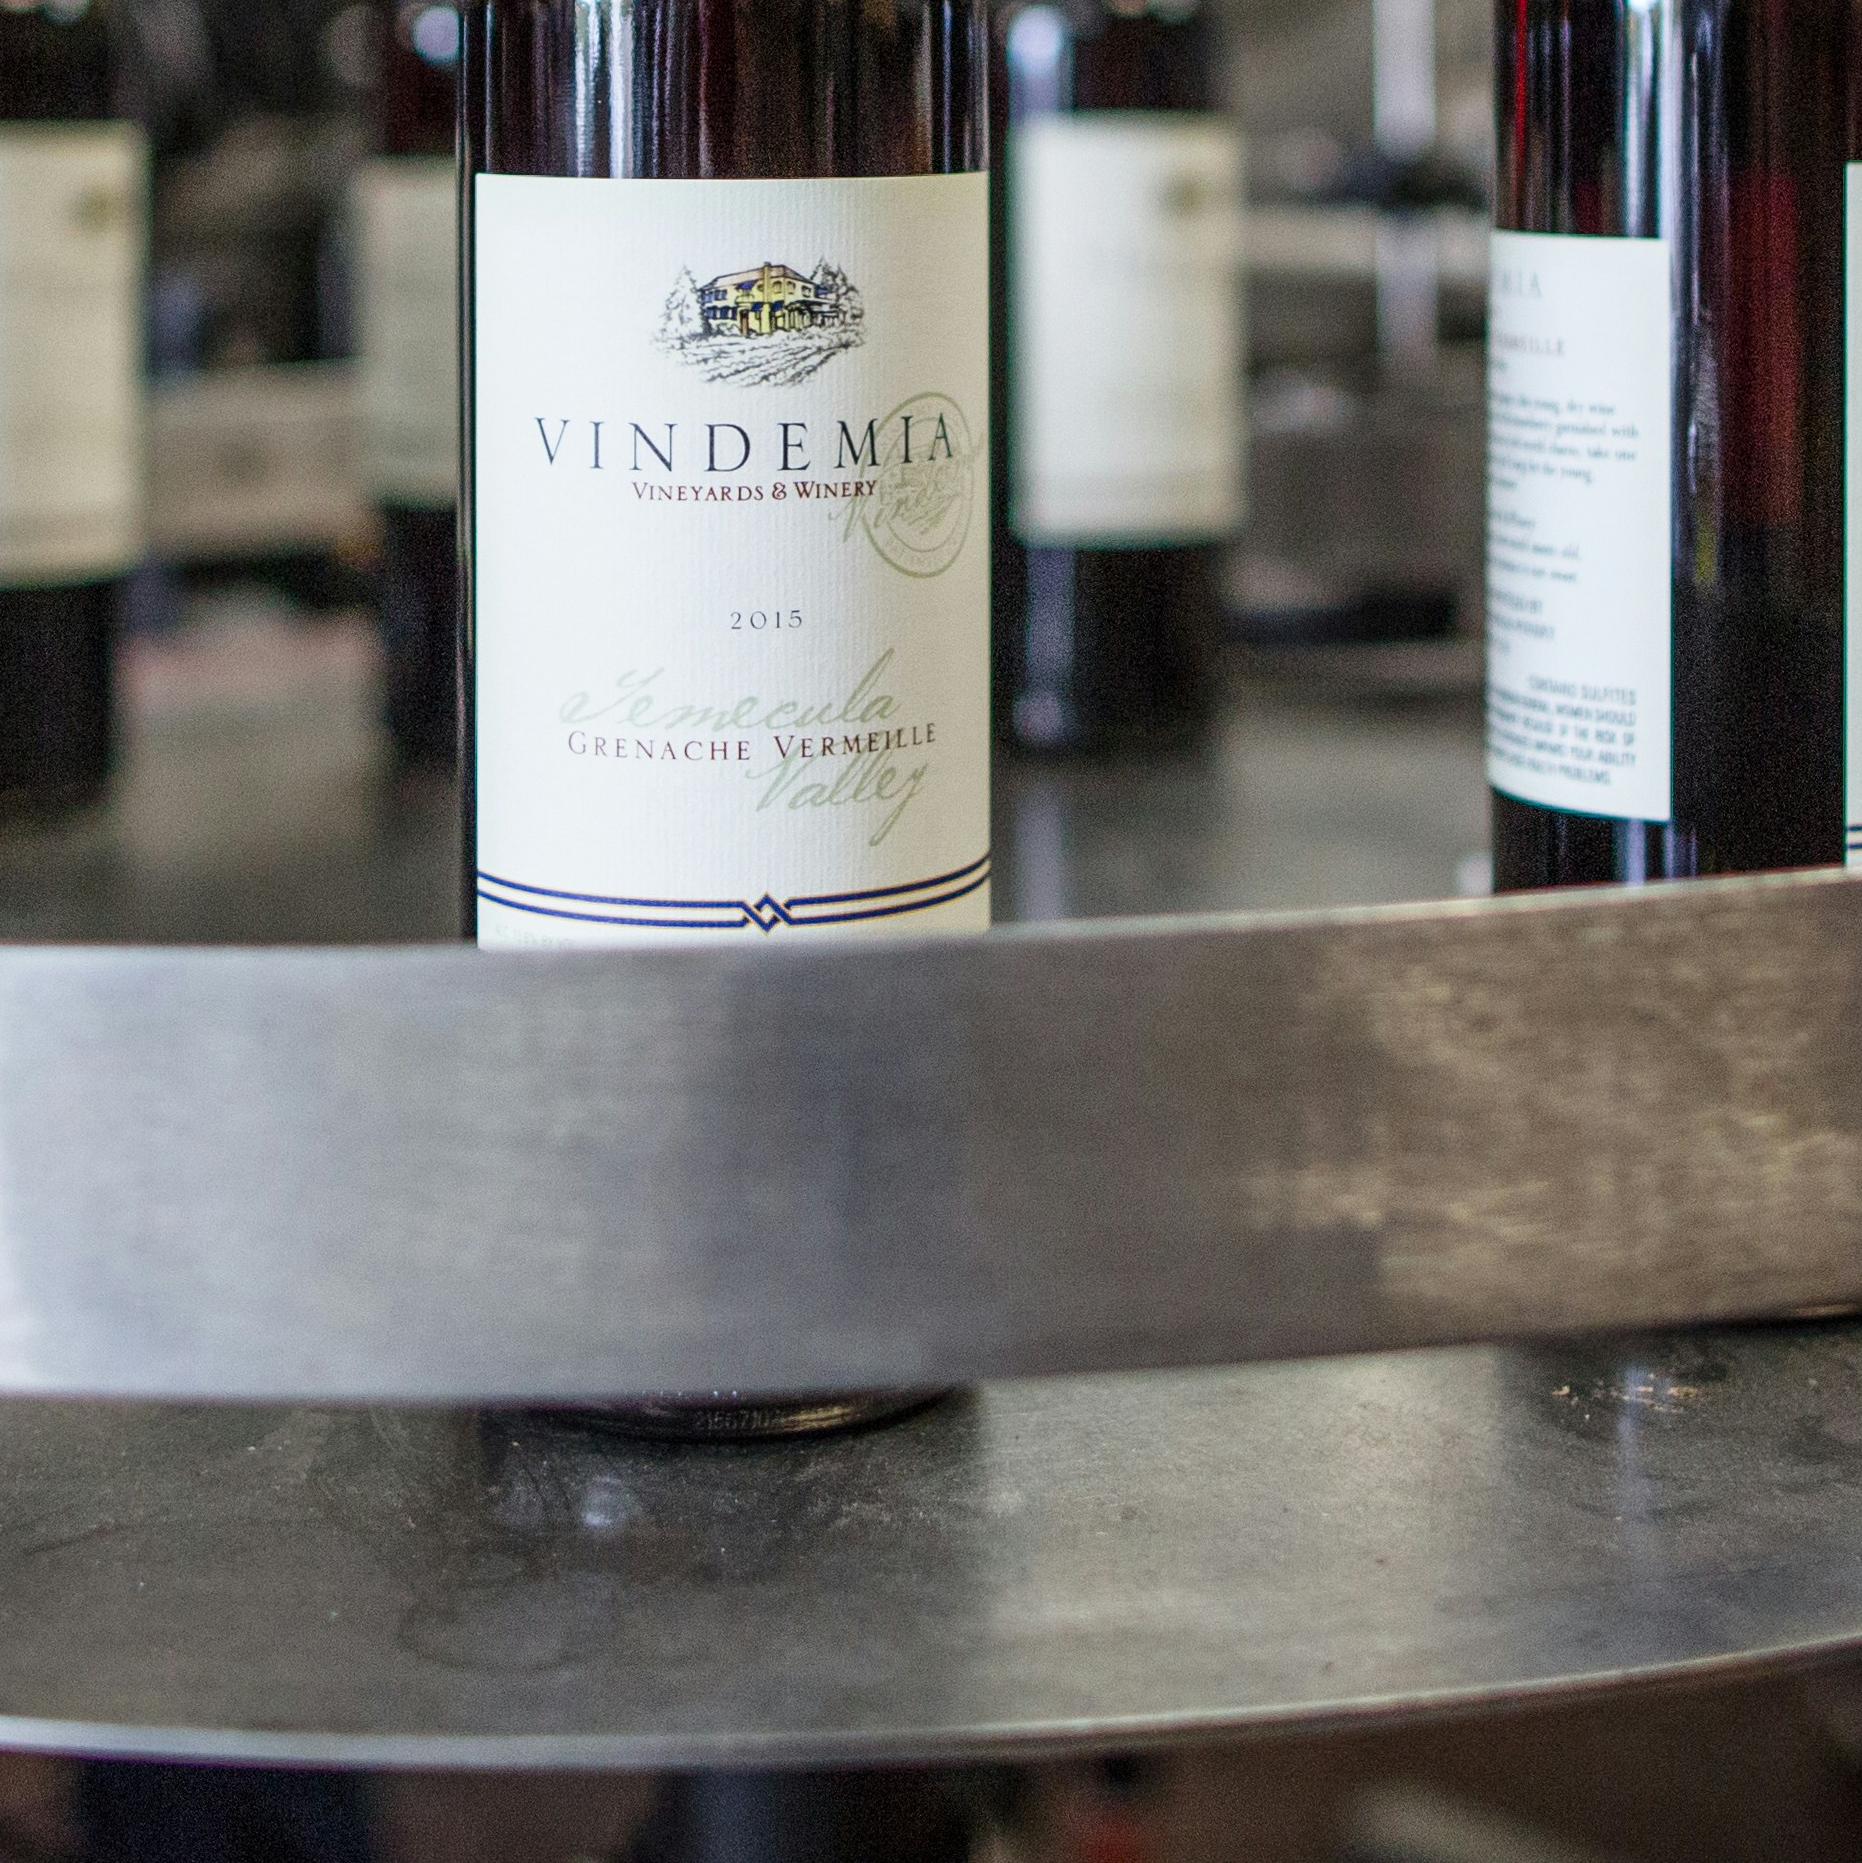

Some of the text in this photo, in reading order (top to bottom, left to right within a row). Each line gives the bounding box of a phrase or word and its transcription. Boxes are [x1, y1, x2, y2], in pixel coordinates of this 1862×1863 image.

[533, 412, 954, 473] VINDEMIA
[632, 479, 878, 502] VINEYARDS & WINERY
[730, 610, 804, 630] 2015
[558, 647, 903, 733] Temecula
[568, 722, 937, 761] GRENACHE VERMEILLE
[743, 734, 930, 847] Valley
